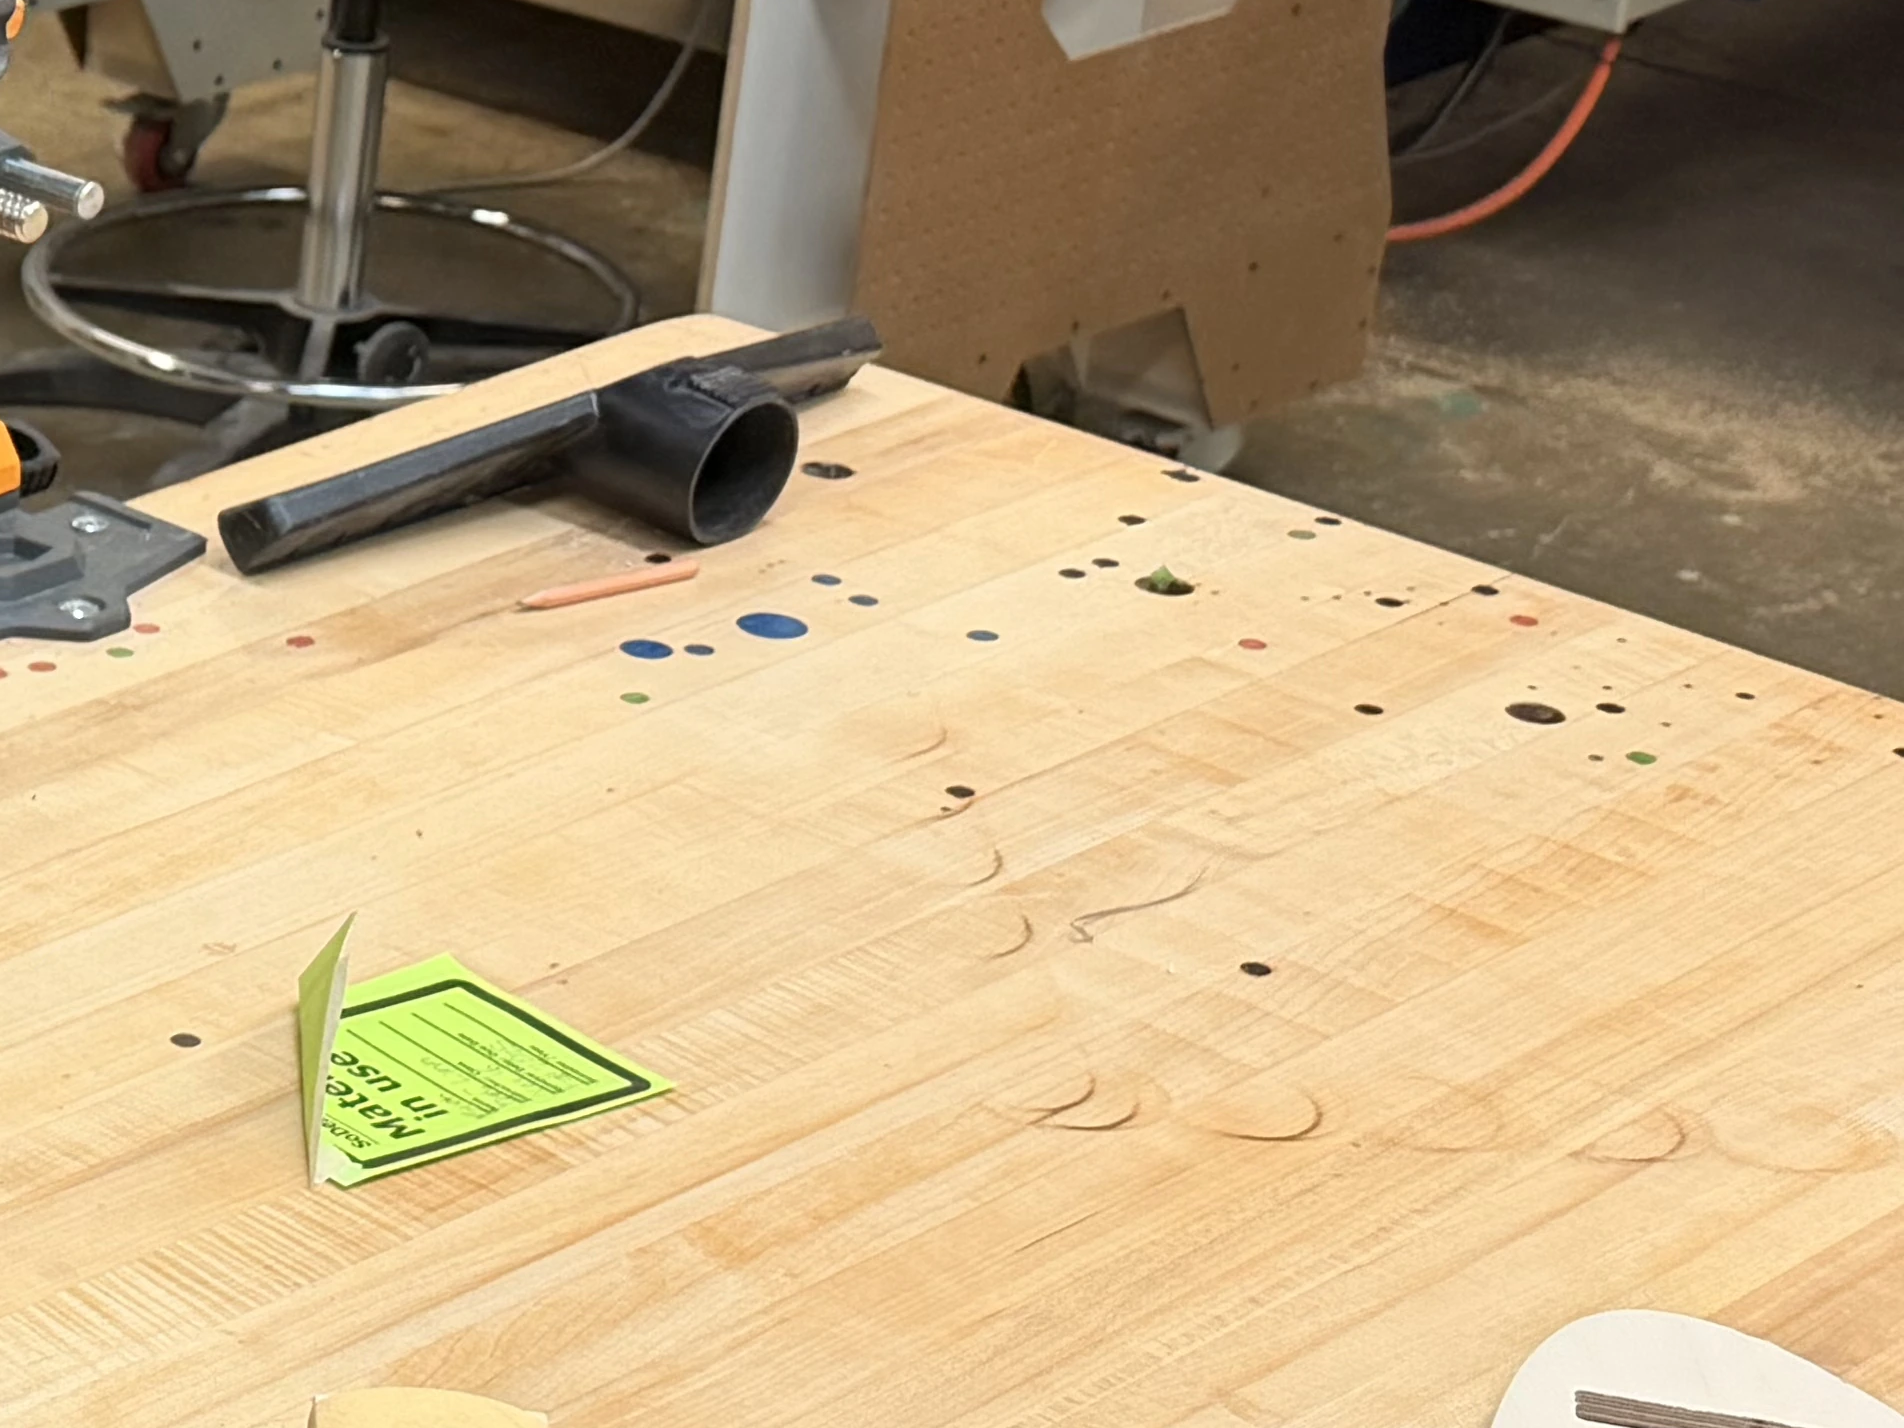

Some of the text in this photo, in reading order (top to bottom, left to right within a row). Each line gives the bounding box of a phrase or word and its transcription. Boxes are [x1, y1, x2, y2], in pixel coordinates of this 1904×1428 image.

[330, 1051, 403, 1093] use
[325, 1075, 426, 1140] Mate
[400, 1095, 450, 1122] in
